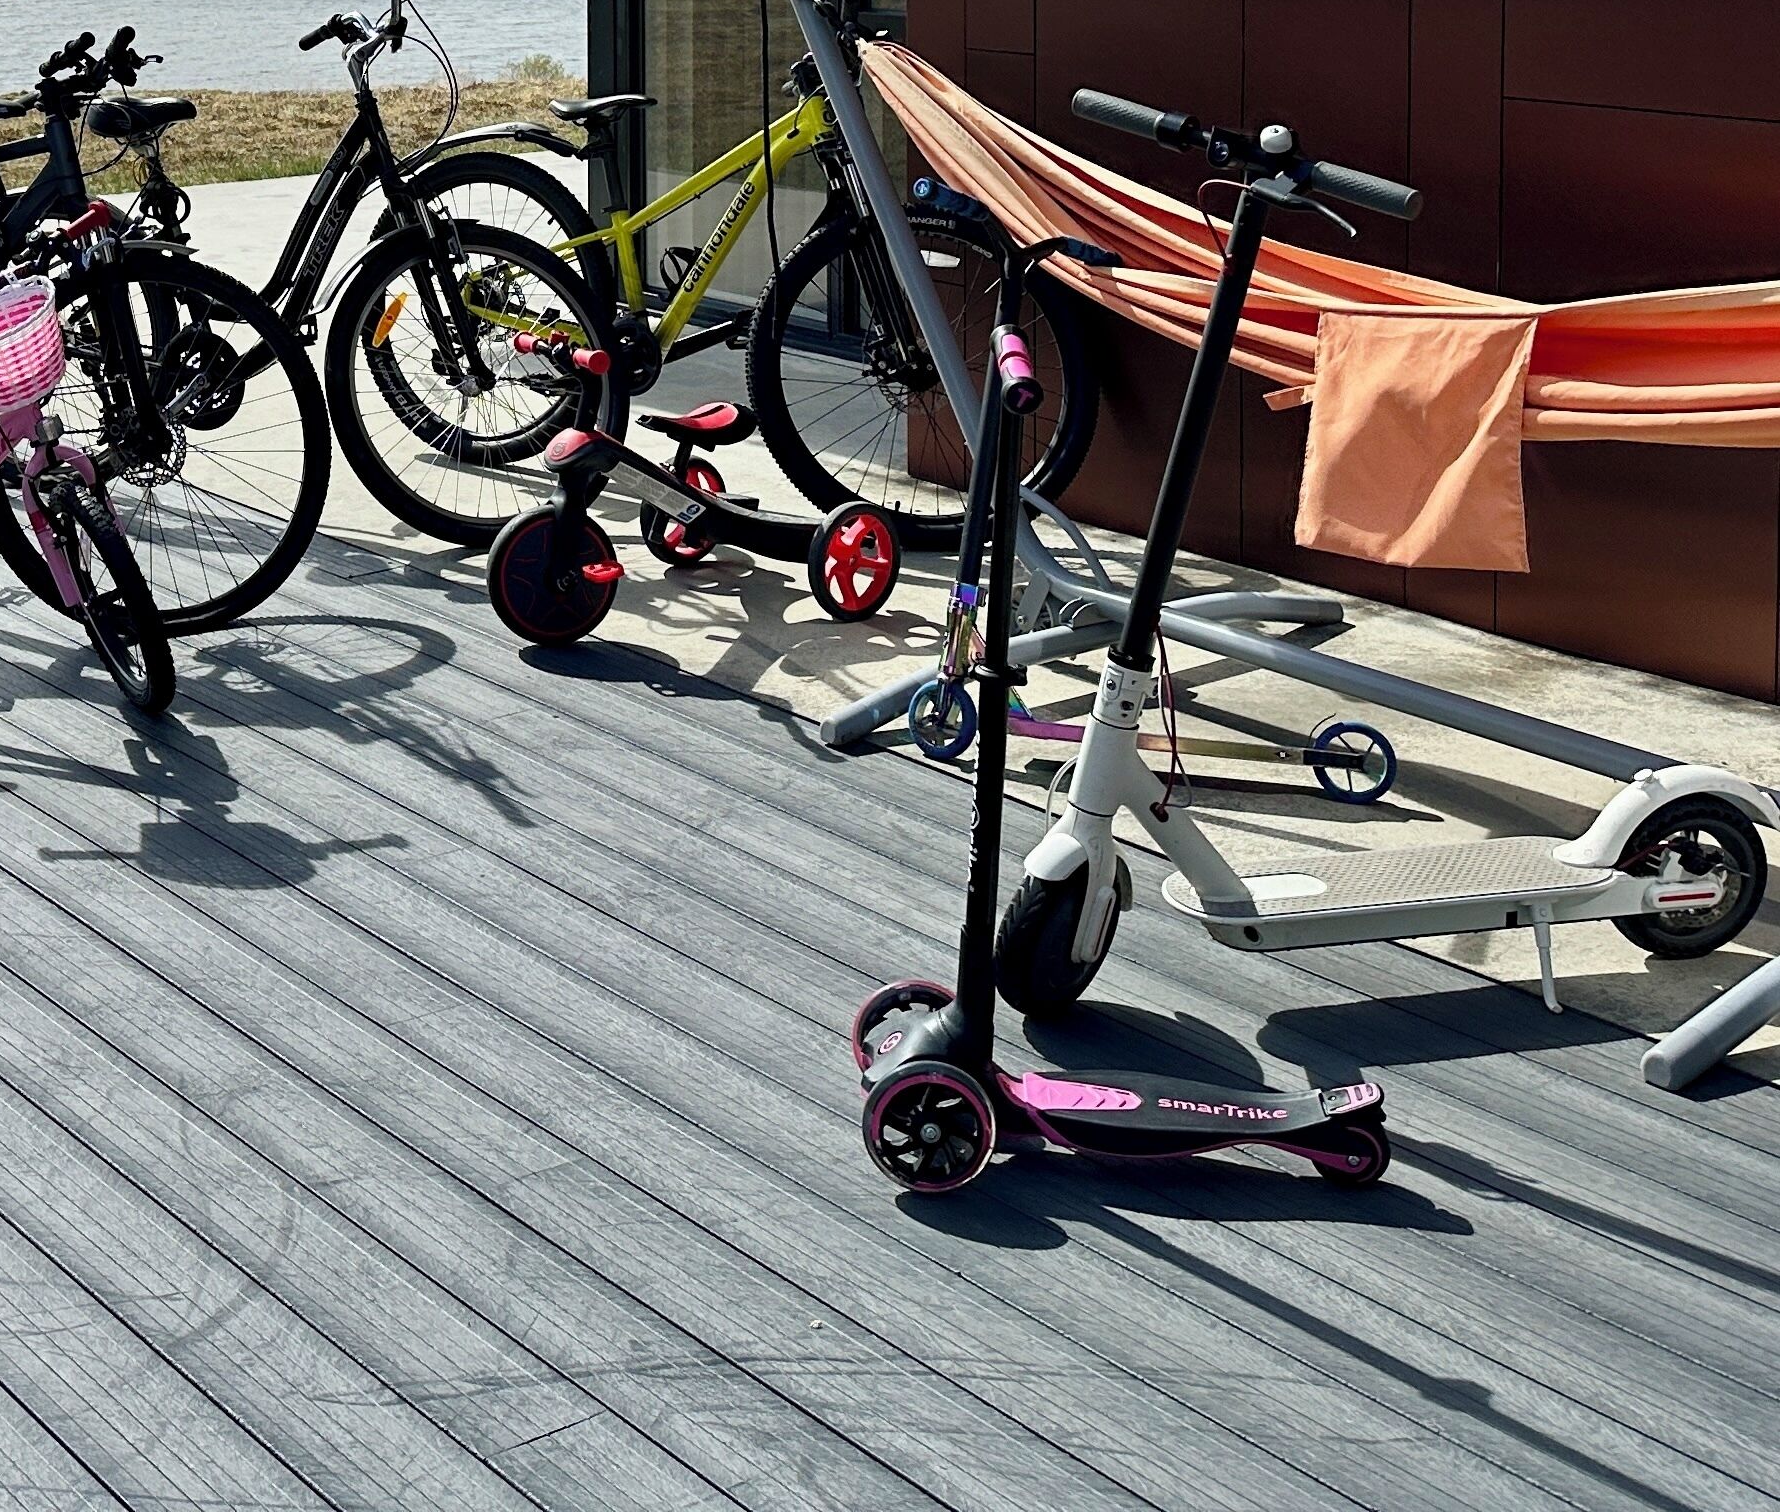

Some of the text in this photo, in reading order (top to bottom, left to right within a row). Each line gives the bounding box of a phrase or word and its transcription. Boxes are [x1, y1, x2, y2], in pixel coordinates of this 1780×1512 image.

[303, 199, 345, 277] TREK
[683, 181, 756, 293] cannondale
[1157, 1097, 1289, 1120] smarTrike
